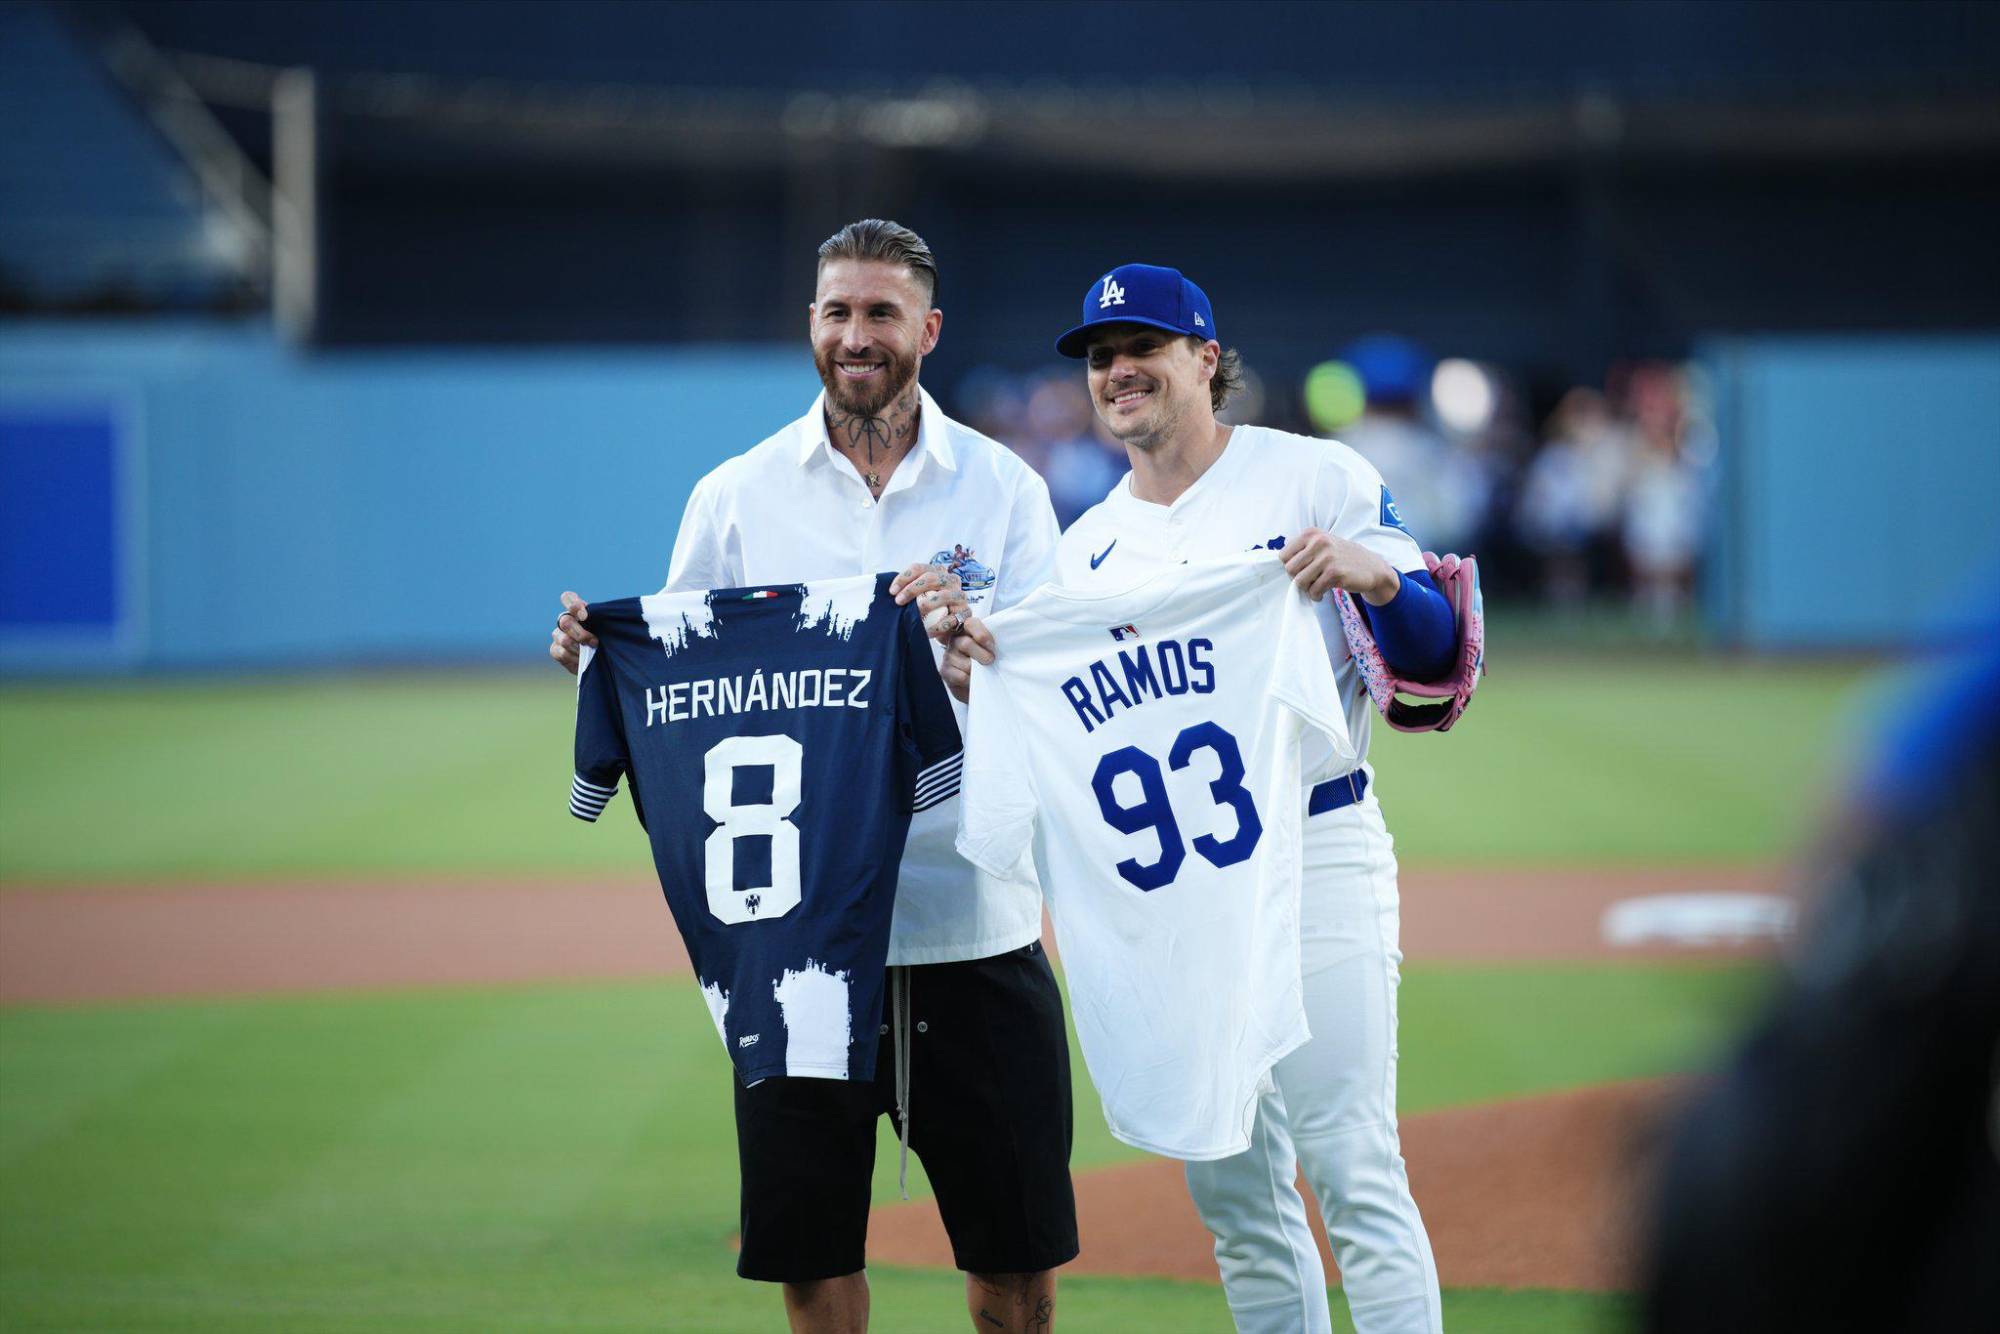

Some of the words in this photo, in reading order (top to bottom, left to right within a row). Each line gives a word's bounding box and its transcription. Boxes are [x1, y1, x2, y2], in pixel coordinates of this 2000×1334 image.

[1099, 275, 1125, 309] LA
[645, 668, 872, 727] HERNÁNDEZ
[1060, 638, 1216, 733] RAMOS
[703, 733, 803, 925] 8
[1091, 720, 1263, 893] 93
